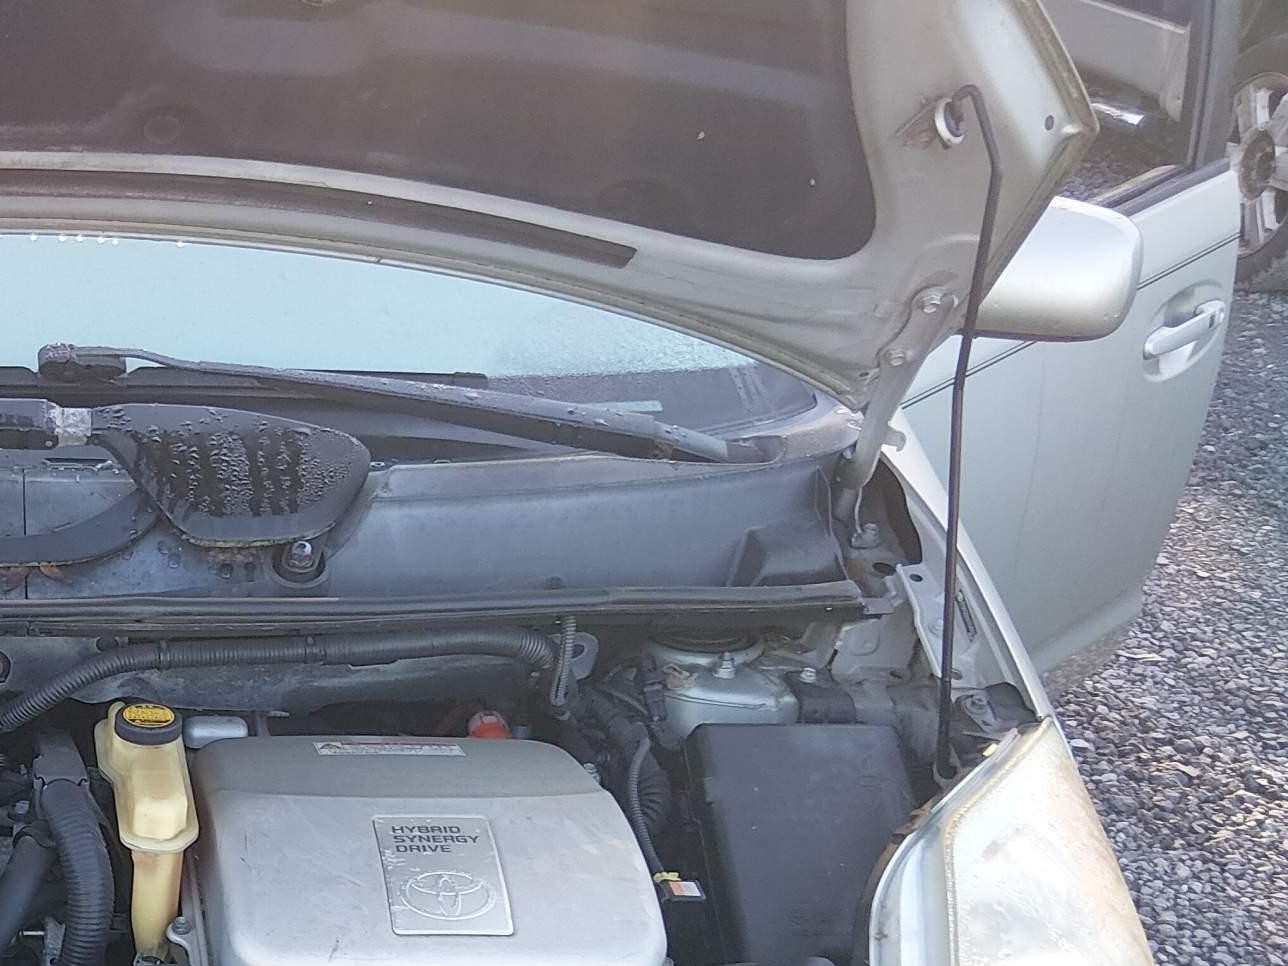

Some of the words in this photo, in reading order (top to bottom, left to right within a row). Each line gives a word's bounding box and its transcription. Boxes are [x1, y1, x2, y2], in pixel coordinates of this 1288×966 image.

[391, 825, 462, 834] HYBRID
[392, 835, 480, 844] SYNERGY
[395, 844, 453, 853] DRIVE
